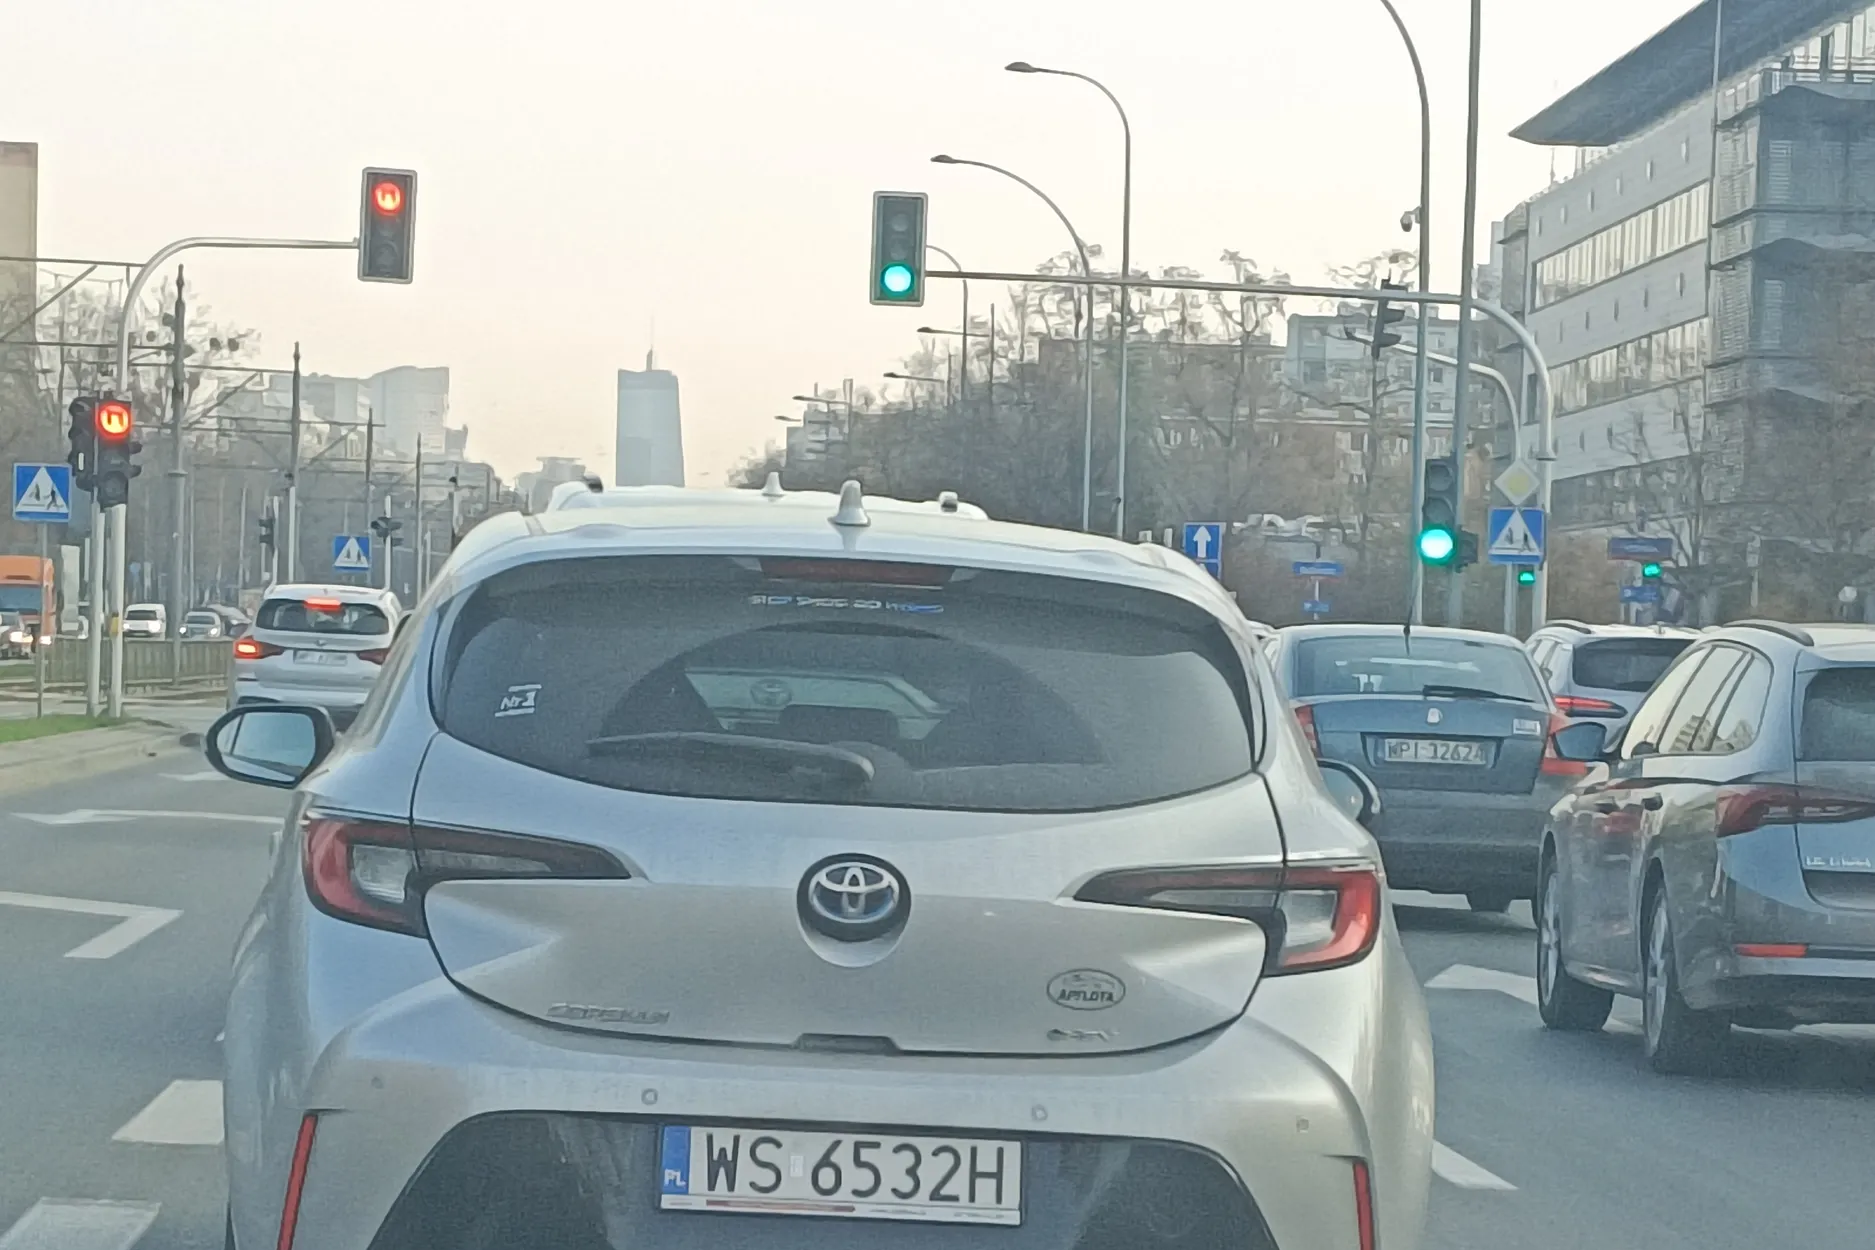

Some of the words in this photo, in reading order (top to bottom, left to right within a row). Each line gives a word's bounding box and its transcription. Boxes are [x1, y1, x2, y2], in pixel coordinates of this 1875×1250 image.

[664, 1169, 687, 1187] PL
[706, 1132, 783, 1194] WS
[810, 1139, 1005, 1205] 6532H
